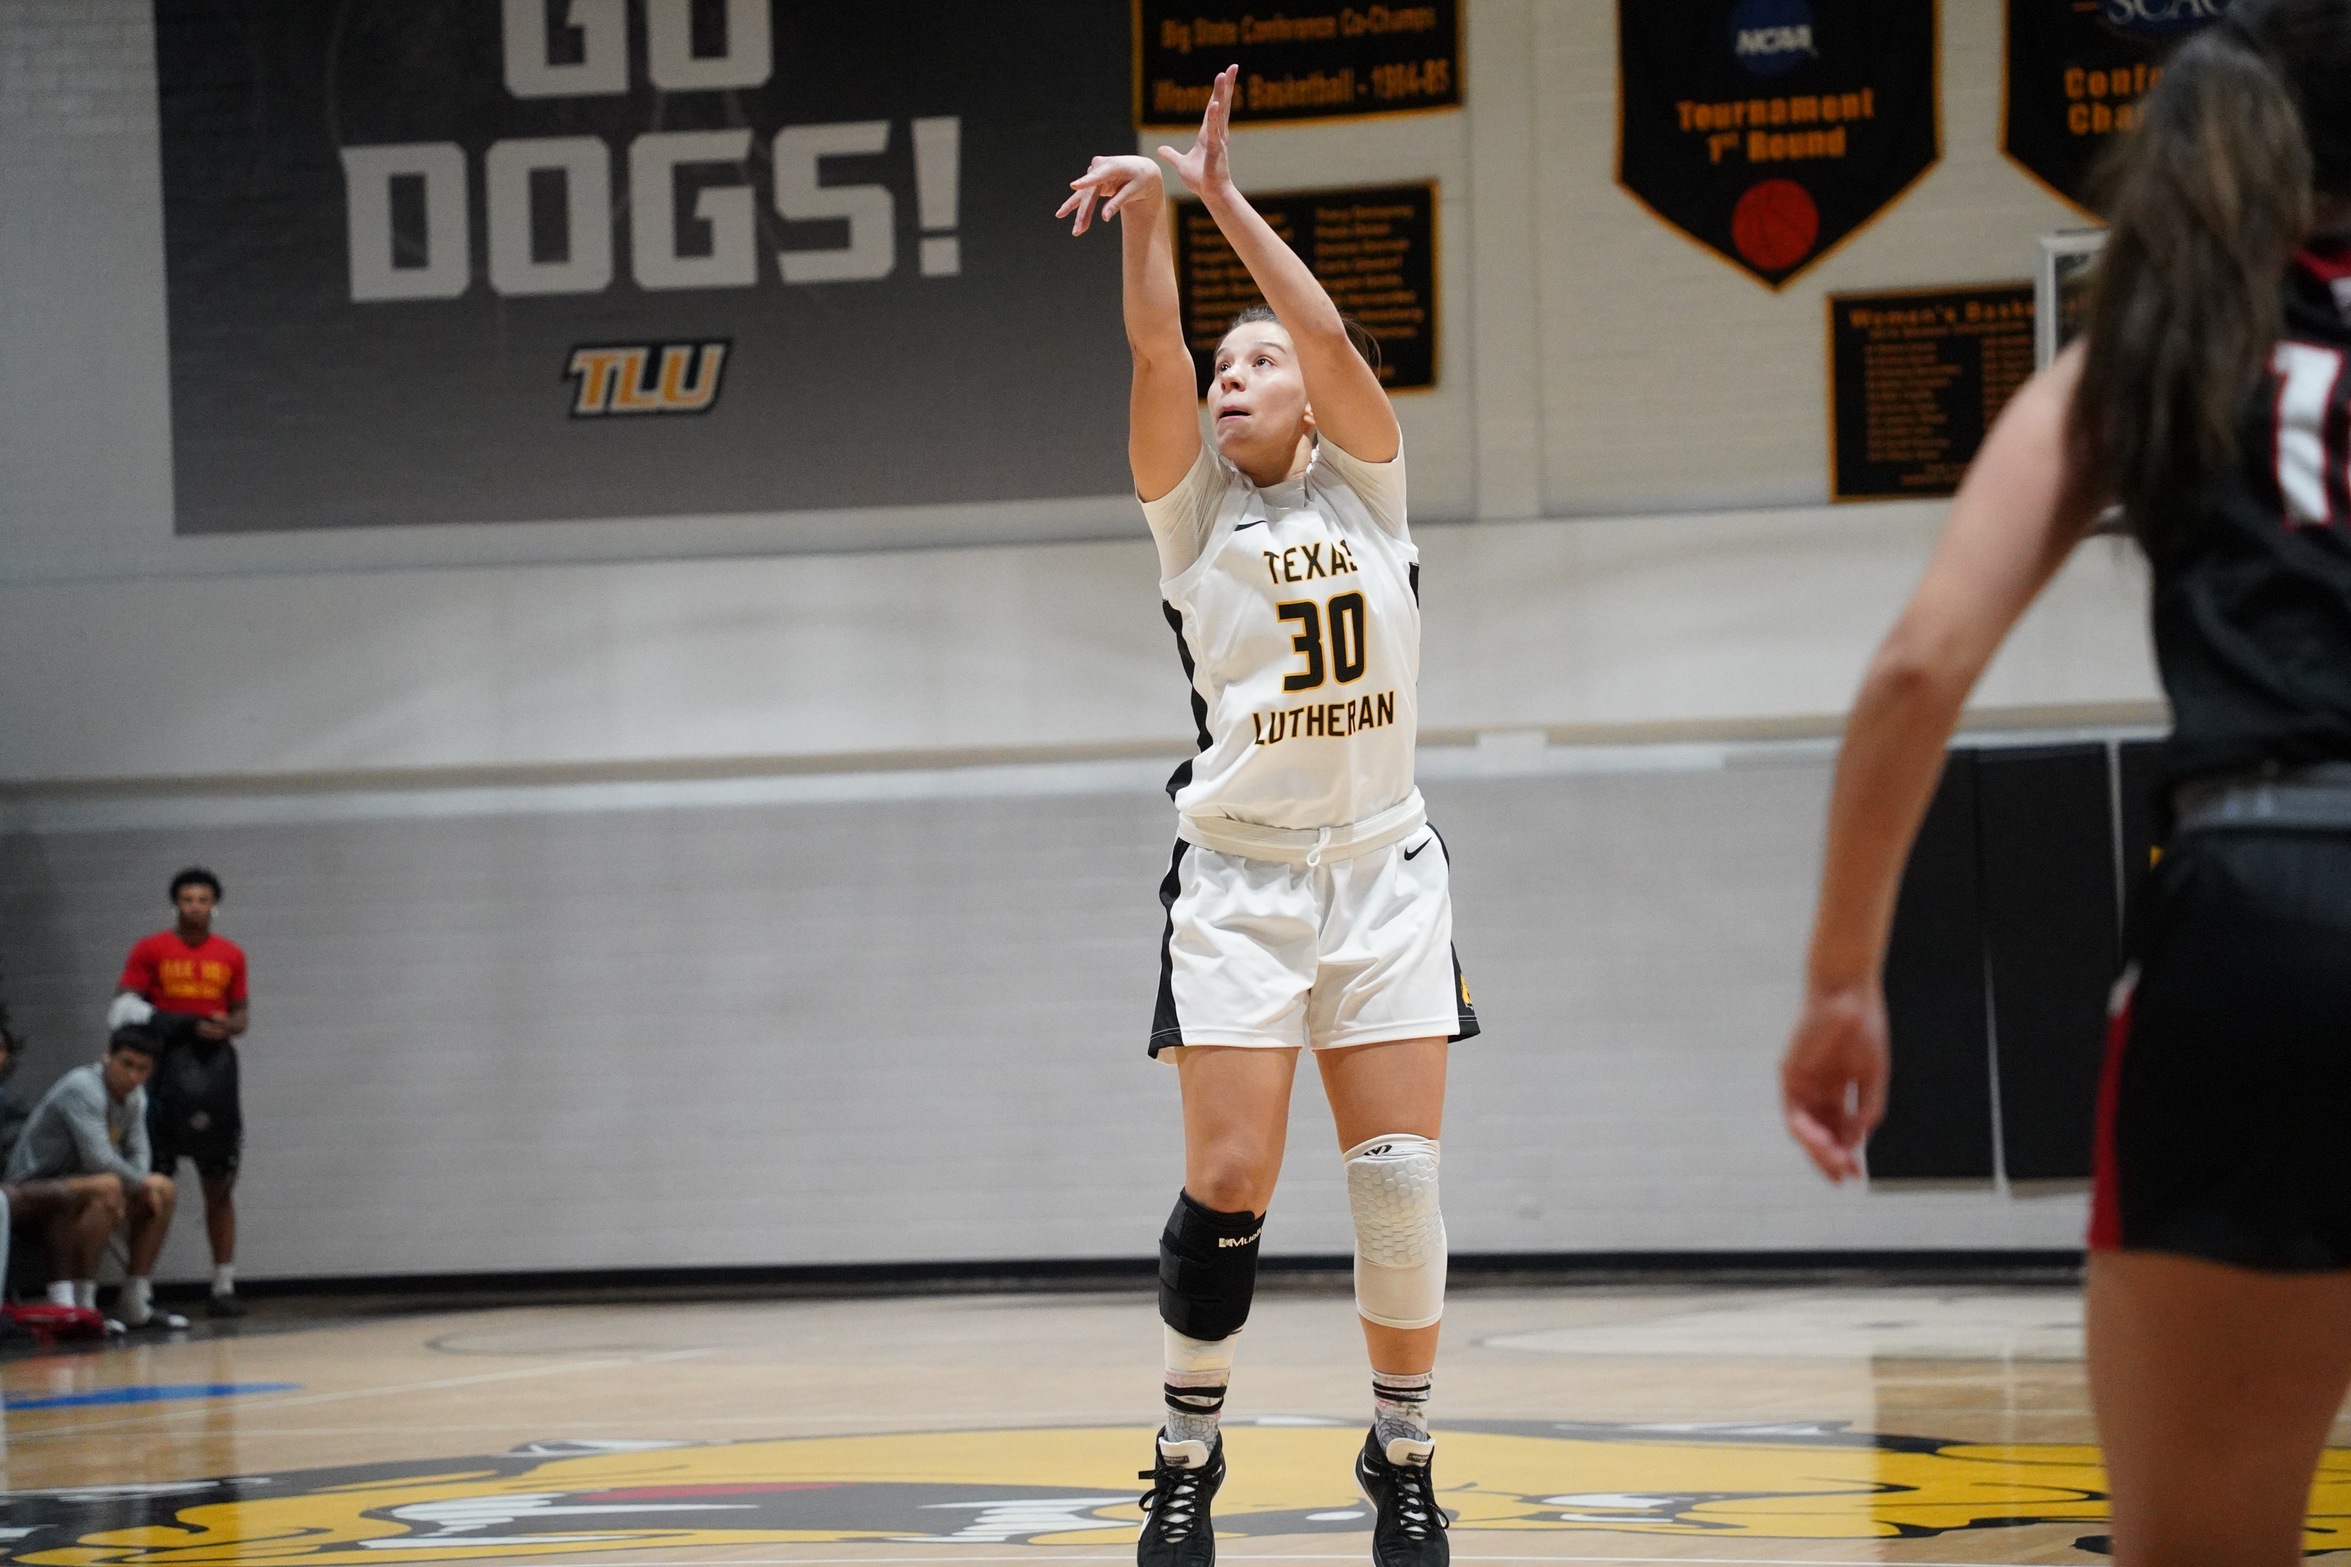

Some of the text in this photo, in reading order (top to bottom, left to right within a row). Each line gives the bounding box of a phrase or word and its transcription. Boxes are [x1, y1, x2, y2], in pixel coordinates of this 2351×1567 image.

[503, 0, 772, 98] GO
[1161, 4, 1437, 54] Big State Conference Co-Champs
[1737, 24, 1813, 56] NCAA
[1249, 67, 1354, 112] Basketball
[1676, 87, 1875, 131] Tournament
[1747, 125, 1847, 163] Round
[340, 116, 961, 301] DOGS!
[566, 341, 729, 417] TLU
[2265, 340, 2351, 531] 1
[1275, 588, 1367, 694] 30
[1252, 690, 1396, 747] LUTHERAN
